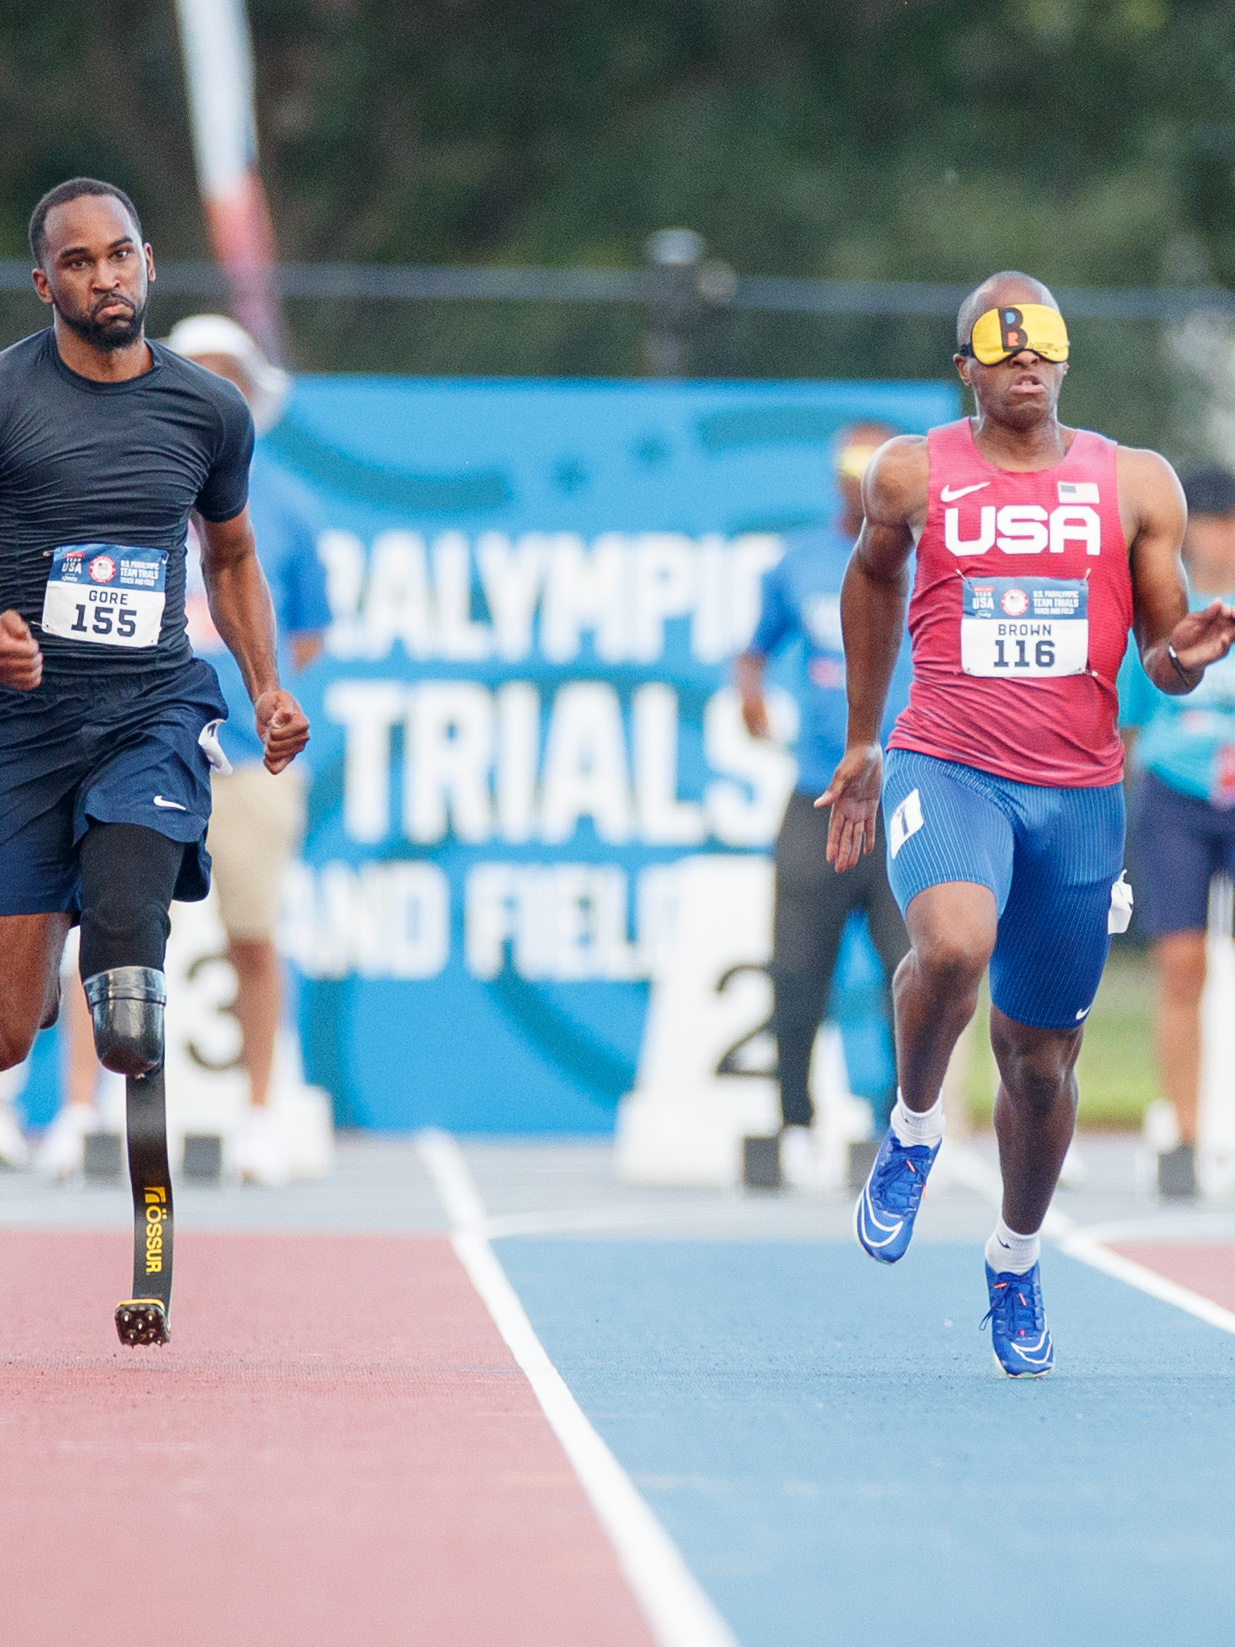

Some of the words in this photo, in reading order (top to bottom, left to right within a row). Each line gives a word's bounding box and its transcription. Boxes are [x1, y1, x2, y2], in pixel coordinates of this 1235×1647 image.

[944, 505, 1101, 557] USA
[61, 563, 82, 574] USA
[89, 590, 128, 605] GORE
[972, 598, 995, 610] USA
[70, 603, 137, 637] 155
[998, 624, 1052, 636] BROWN
[993, 639, 1055, 668] 116
[325, 681, 799, 848] TRIALS
[185, 952, 248, 1071] 3
[714, 963, 782, 1078] 2
[145, 1205, 168, 1275] ÖSSUR
